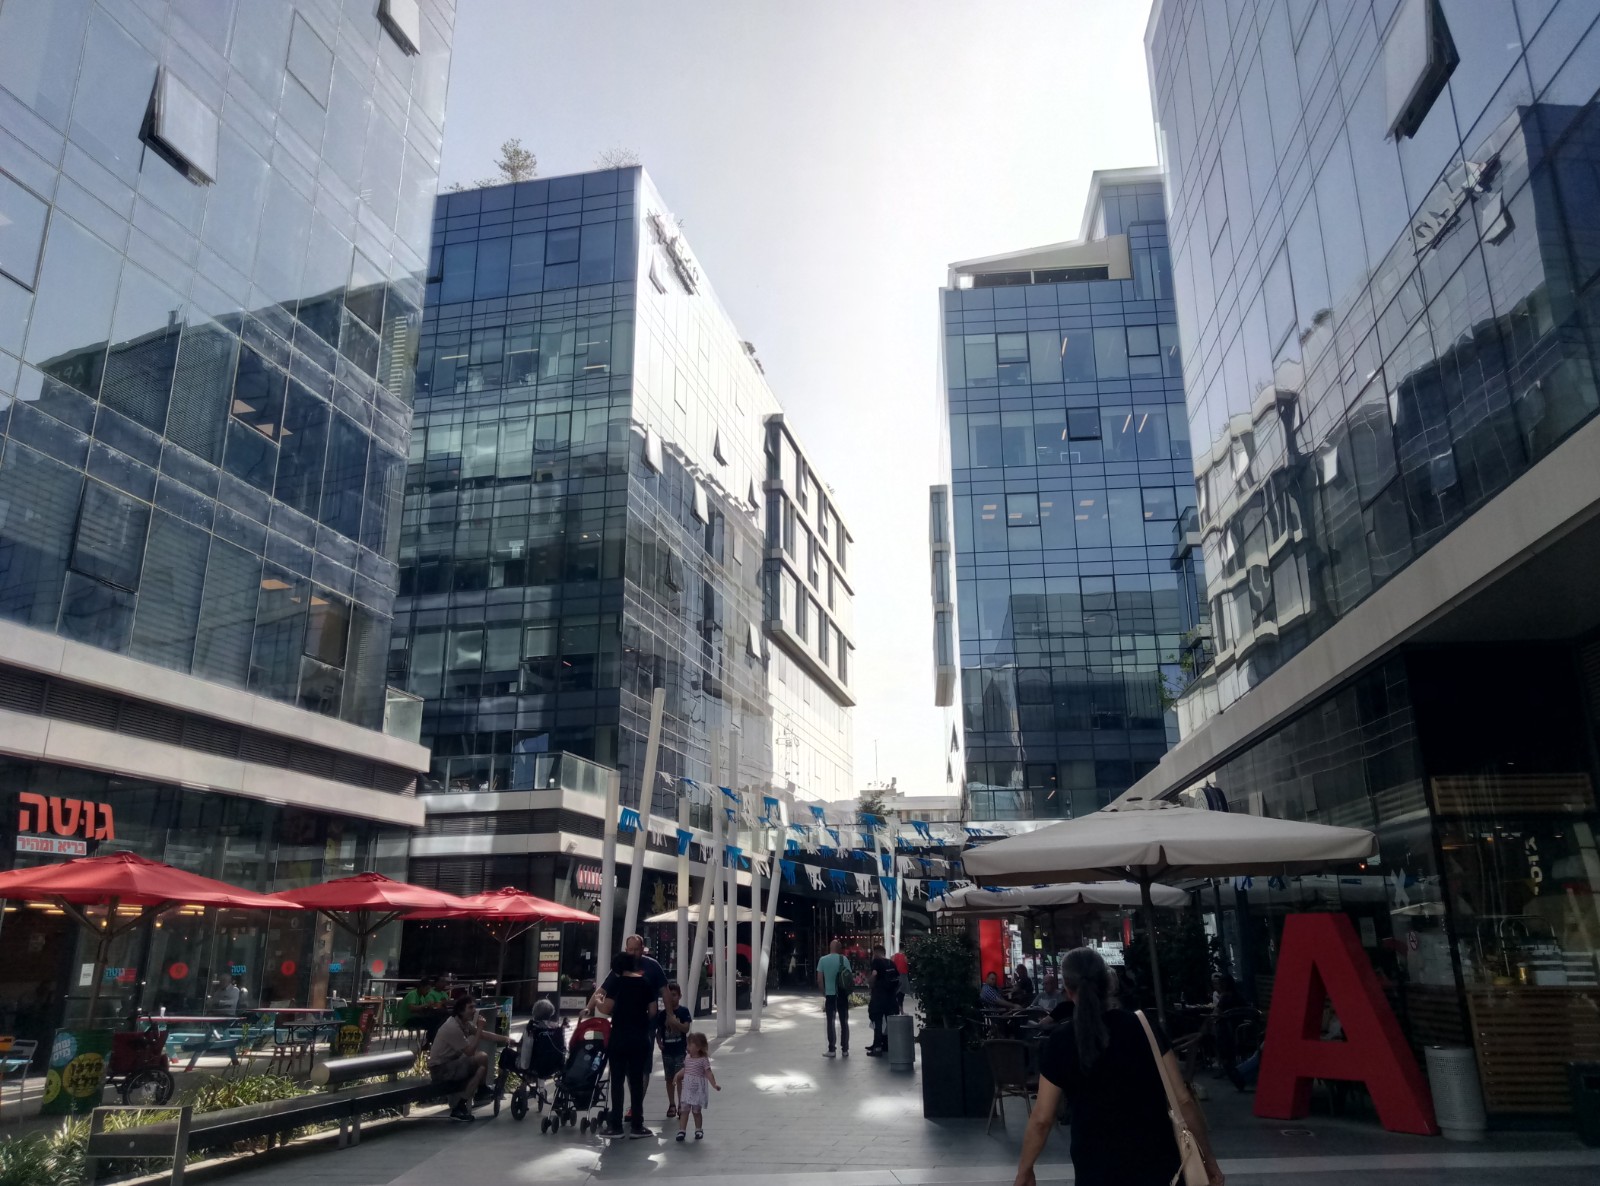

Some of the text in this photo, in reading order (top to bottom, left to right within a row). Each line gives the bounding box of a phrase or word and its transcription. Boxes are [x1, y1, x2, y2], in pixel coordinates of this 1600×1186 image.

[19, 837, 85, 854] בריא ומהיר
[1253, 912, 1440, 1136] A
